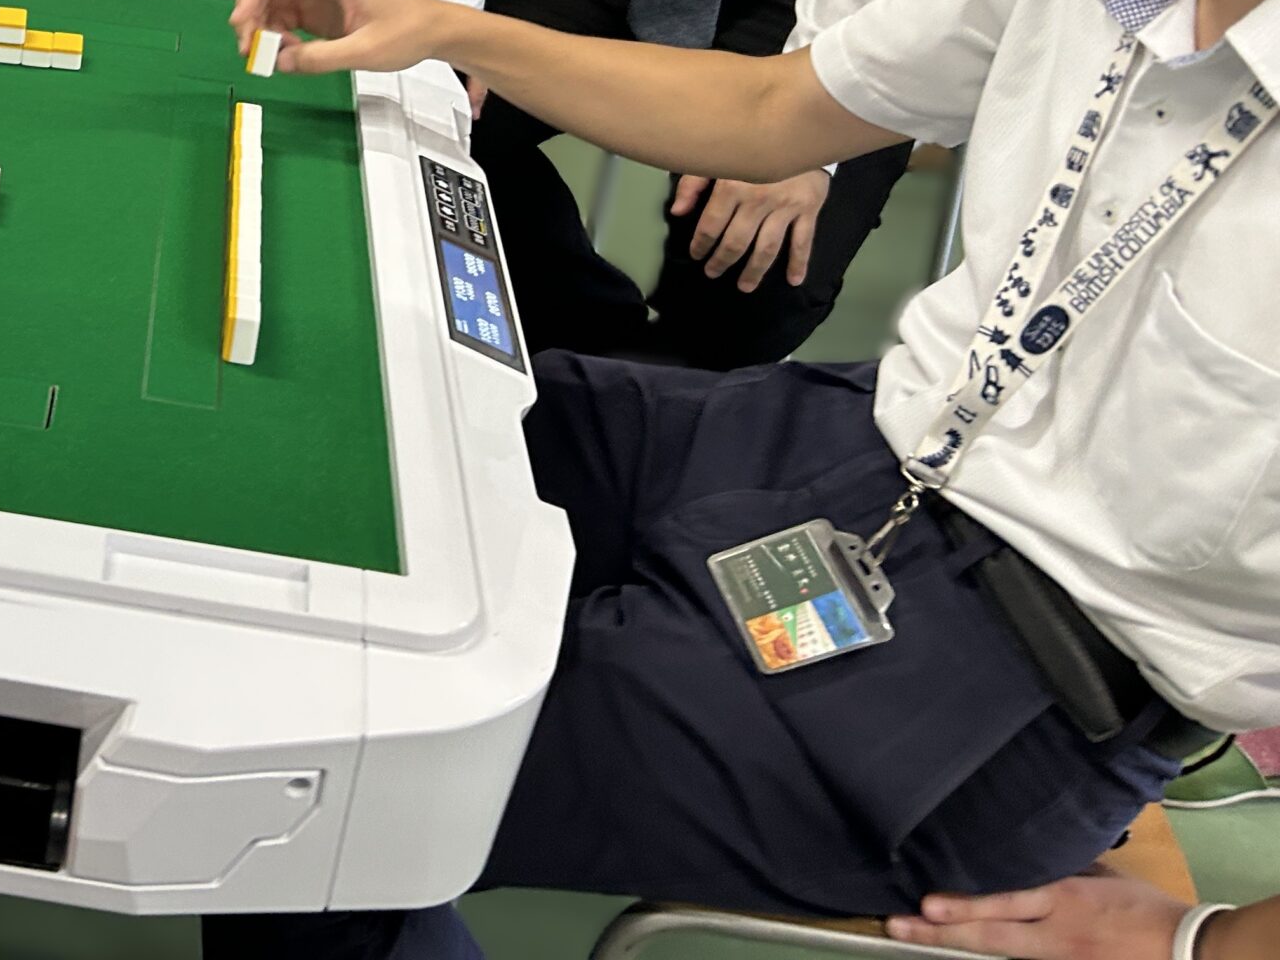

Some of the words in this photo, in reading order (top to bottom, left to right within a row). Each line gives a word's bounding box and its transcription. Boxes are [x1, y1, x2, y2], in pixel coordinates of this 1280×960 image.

[1060, 268, 1090, 295] THE
[1086, 197, 1158, 270] UNIVERSITY
[1159, 176, 1178, 196] OF
[1069, 256, 1123, 314] BRITISH
[1118, 188, 1195, 261] COLUMBIA
